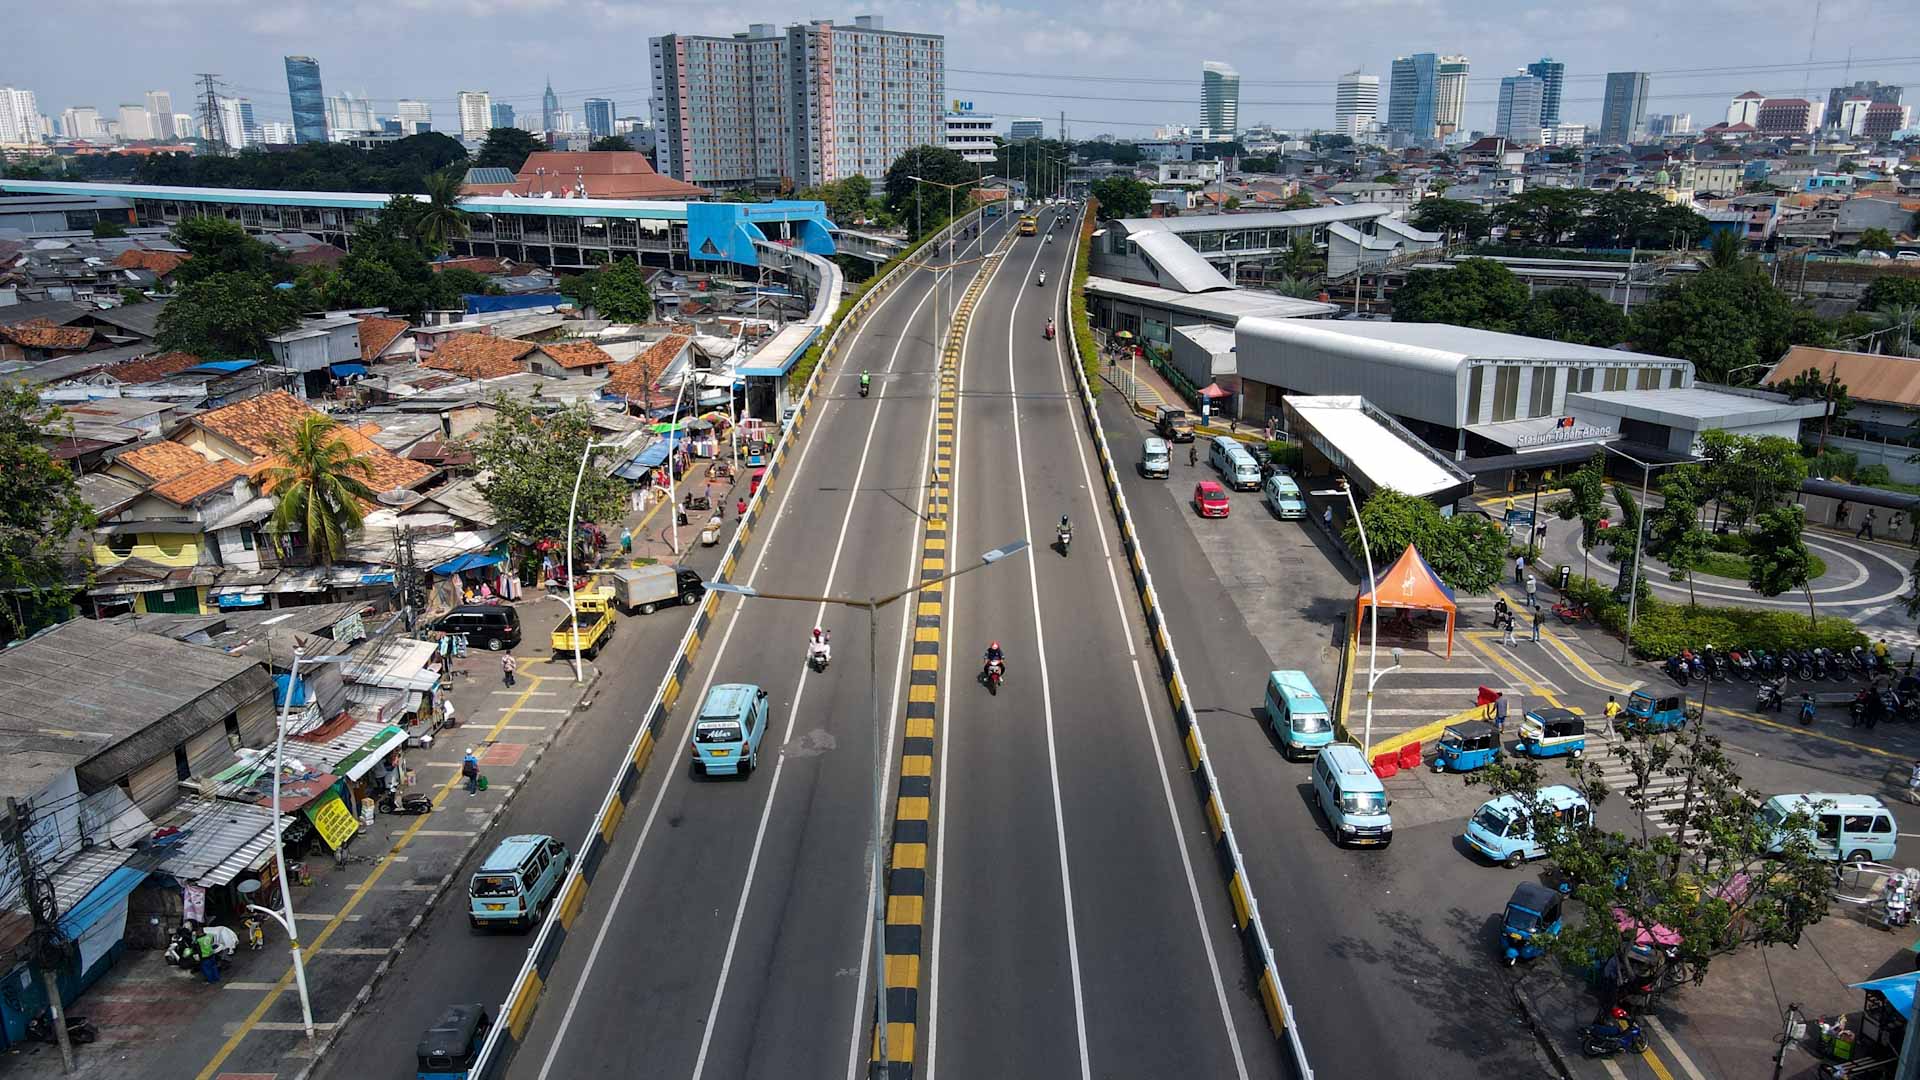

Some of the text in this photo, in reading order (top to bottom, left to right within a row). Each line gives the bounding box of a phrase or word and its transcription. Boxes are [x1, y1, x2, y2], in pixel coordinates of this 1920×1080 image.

[1518, 426, 1610, 445] Stasiun Tanah Abang
